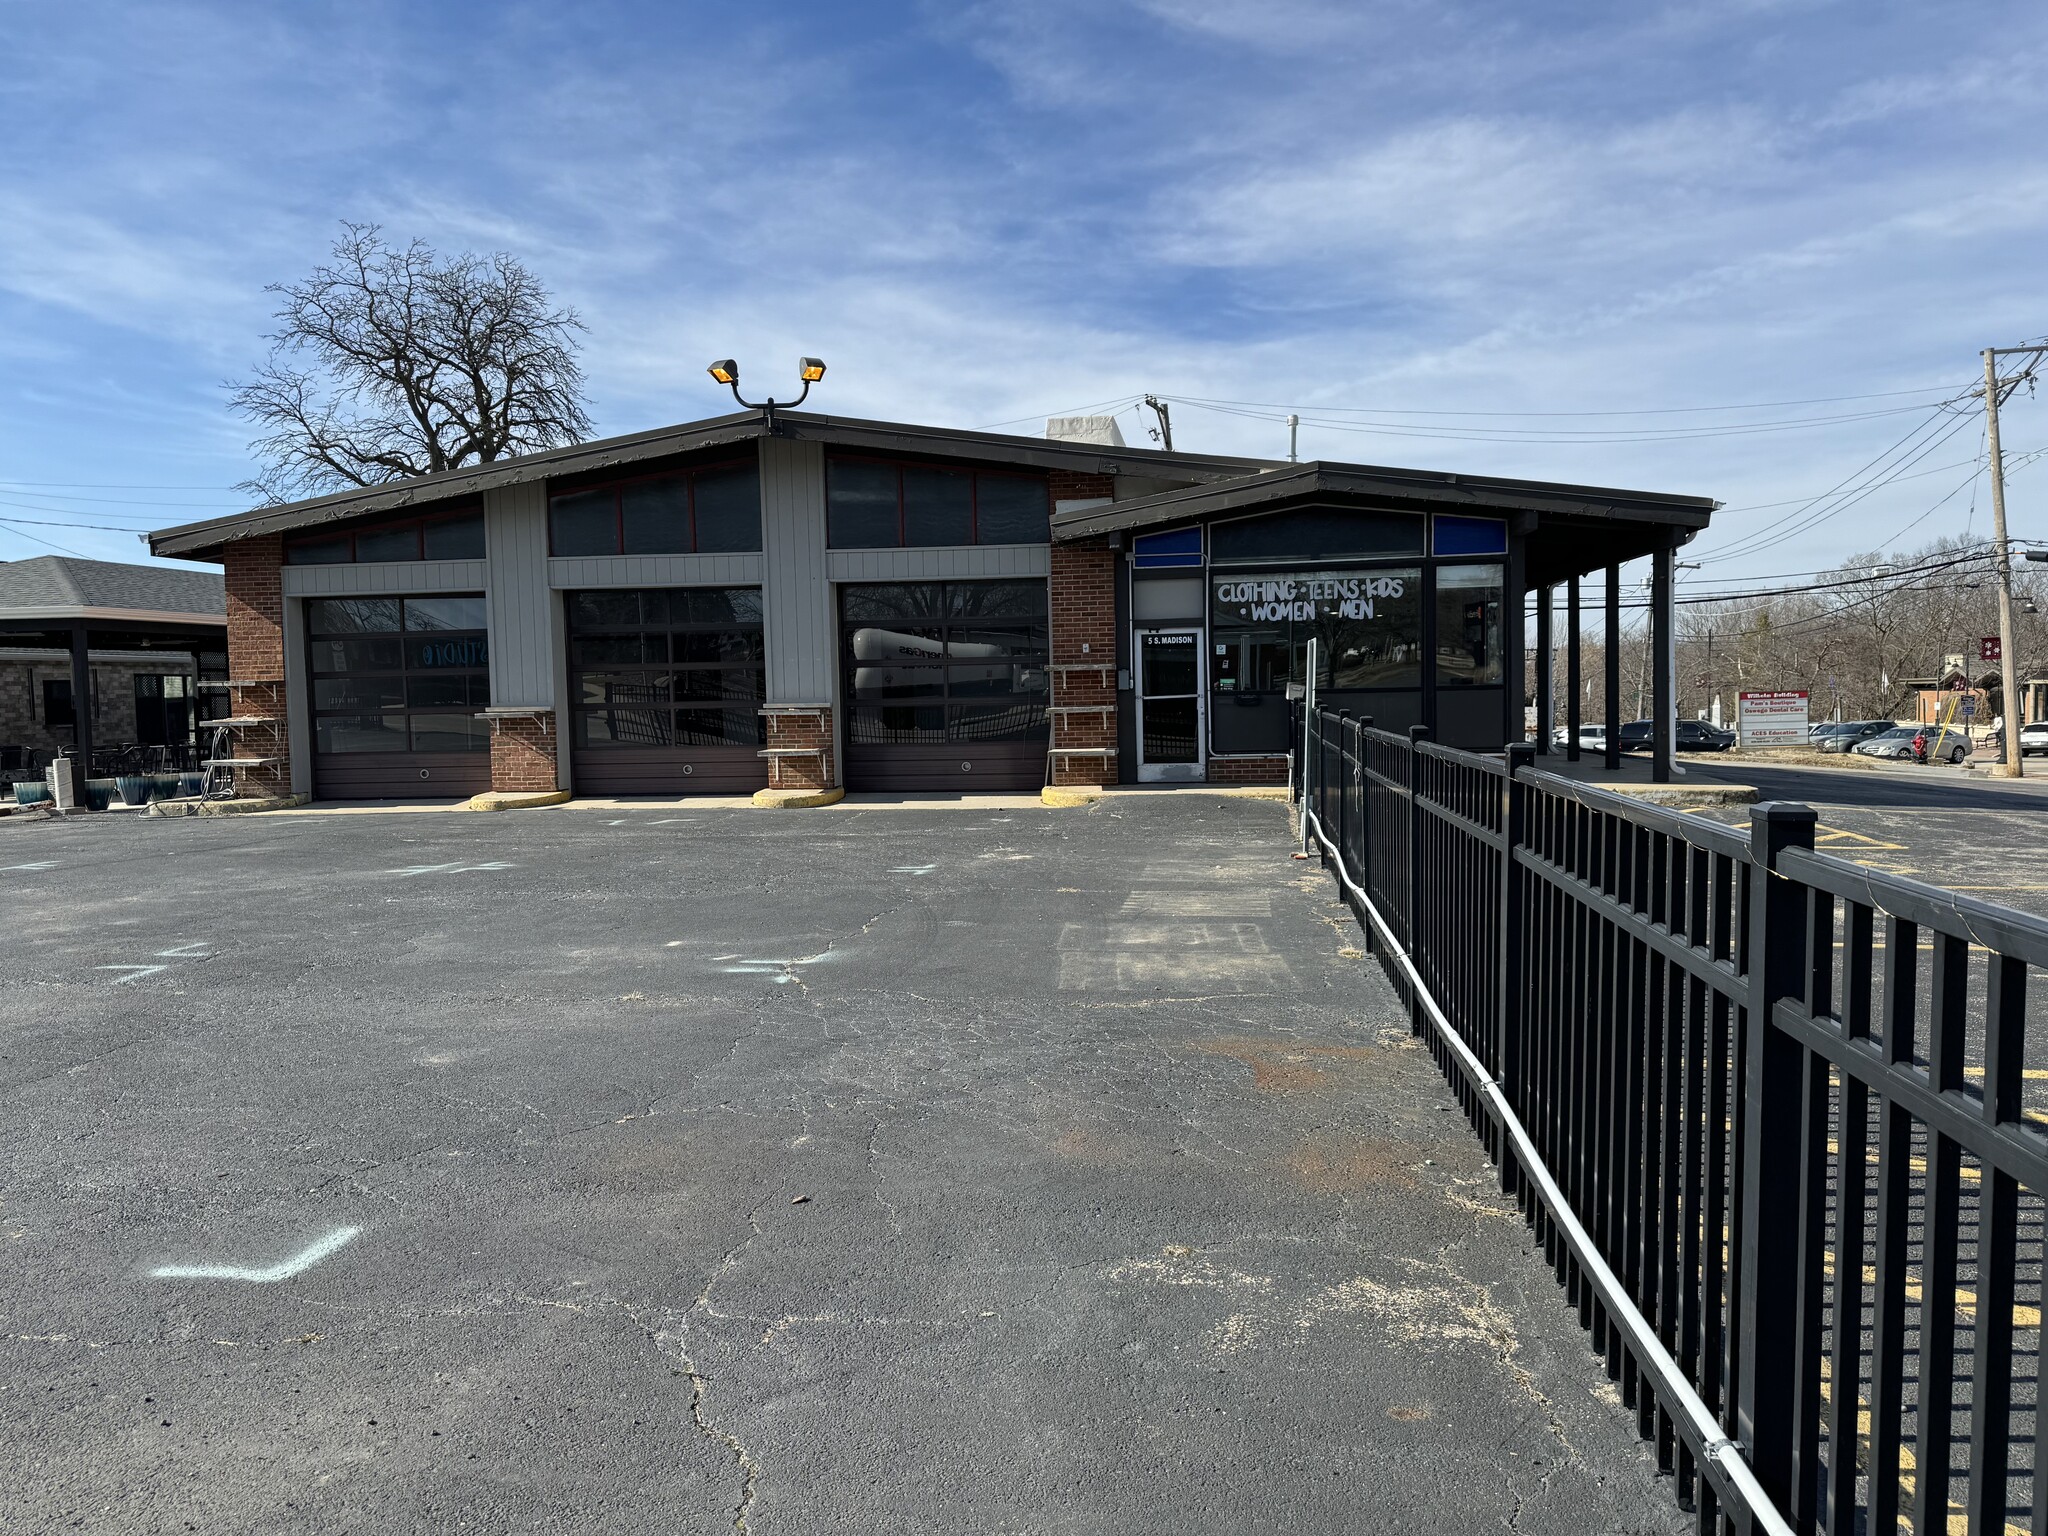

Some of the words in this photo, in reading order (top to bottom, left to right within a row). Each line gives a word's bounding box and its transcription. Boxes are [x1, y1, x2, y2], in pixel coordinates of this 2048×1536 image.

[1218, 580, 1297, 602] CLOTHING
[1307, 579, 1359, 600] TEENS
[1365, 577, 1404, 599] KIDS
[1251, 600, 1316, 622] WOMEN
[1338, 598, 1374, 620] MEN
[1162, 636, 1192, 644] MADISON
